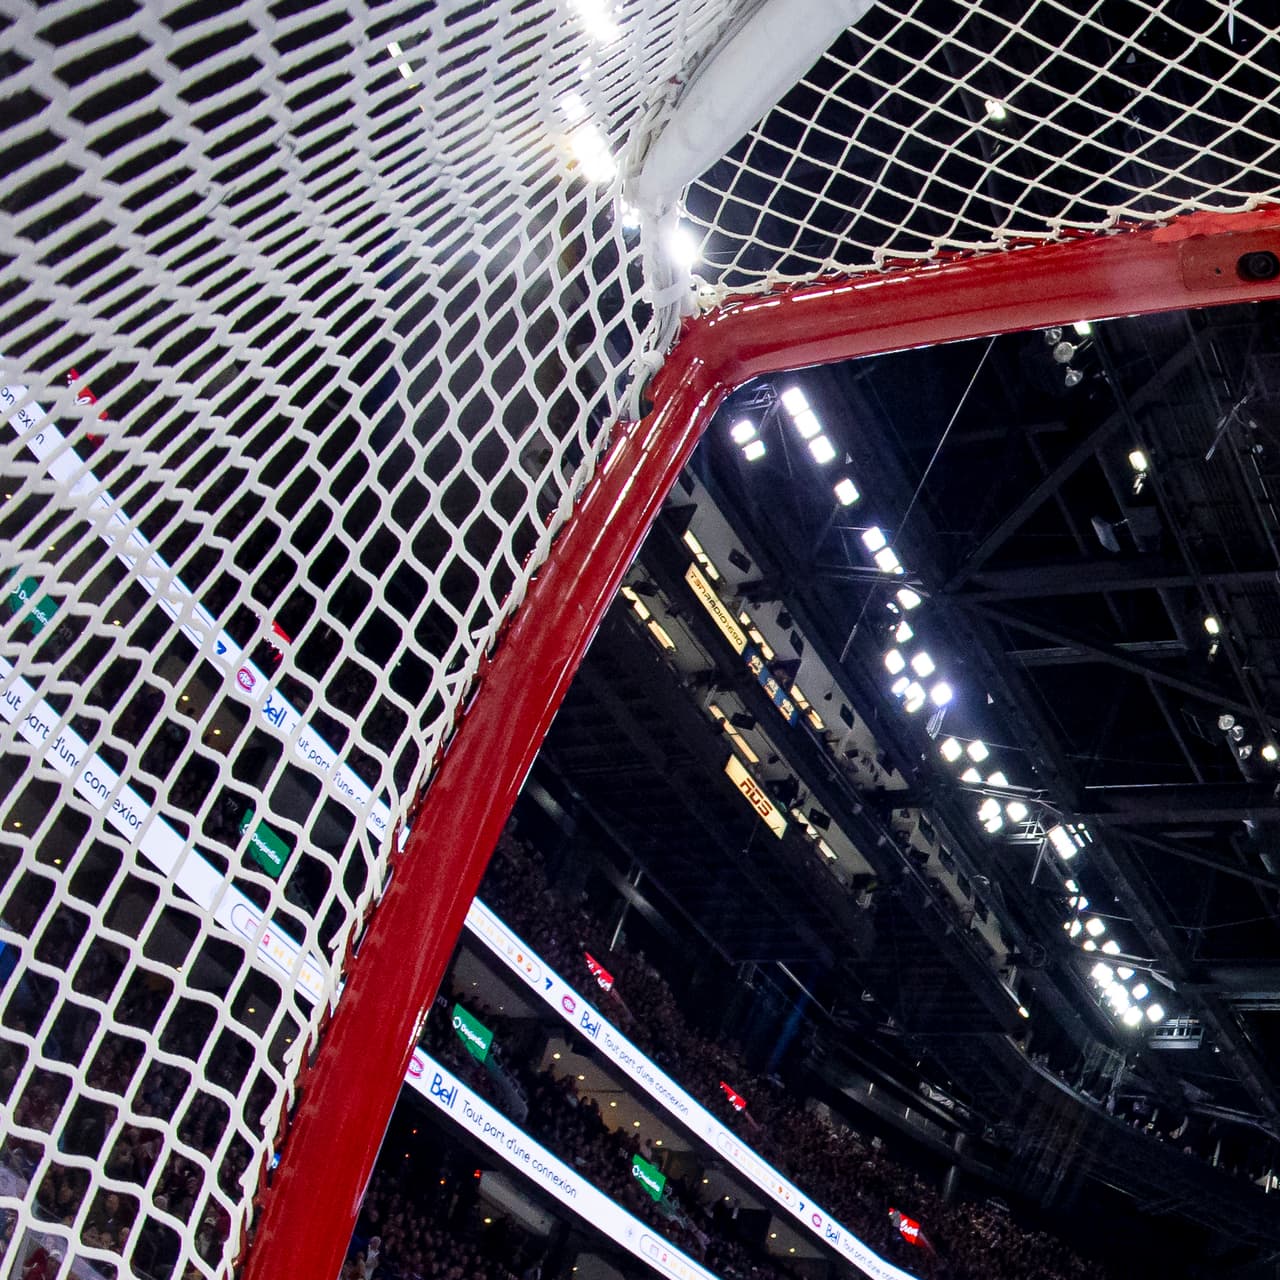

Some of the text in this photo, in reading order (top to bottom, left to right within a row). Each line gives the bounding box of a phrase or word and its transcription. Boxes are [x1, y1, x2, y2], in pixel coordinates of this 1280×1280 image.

[580, 1011, 601, 1040] Bell
[430, 1073, 577, 1199] Bell Tout part d'une connexion
